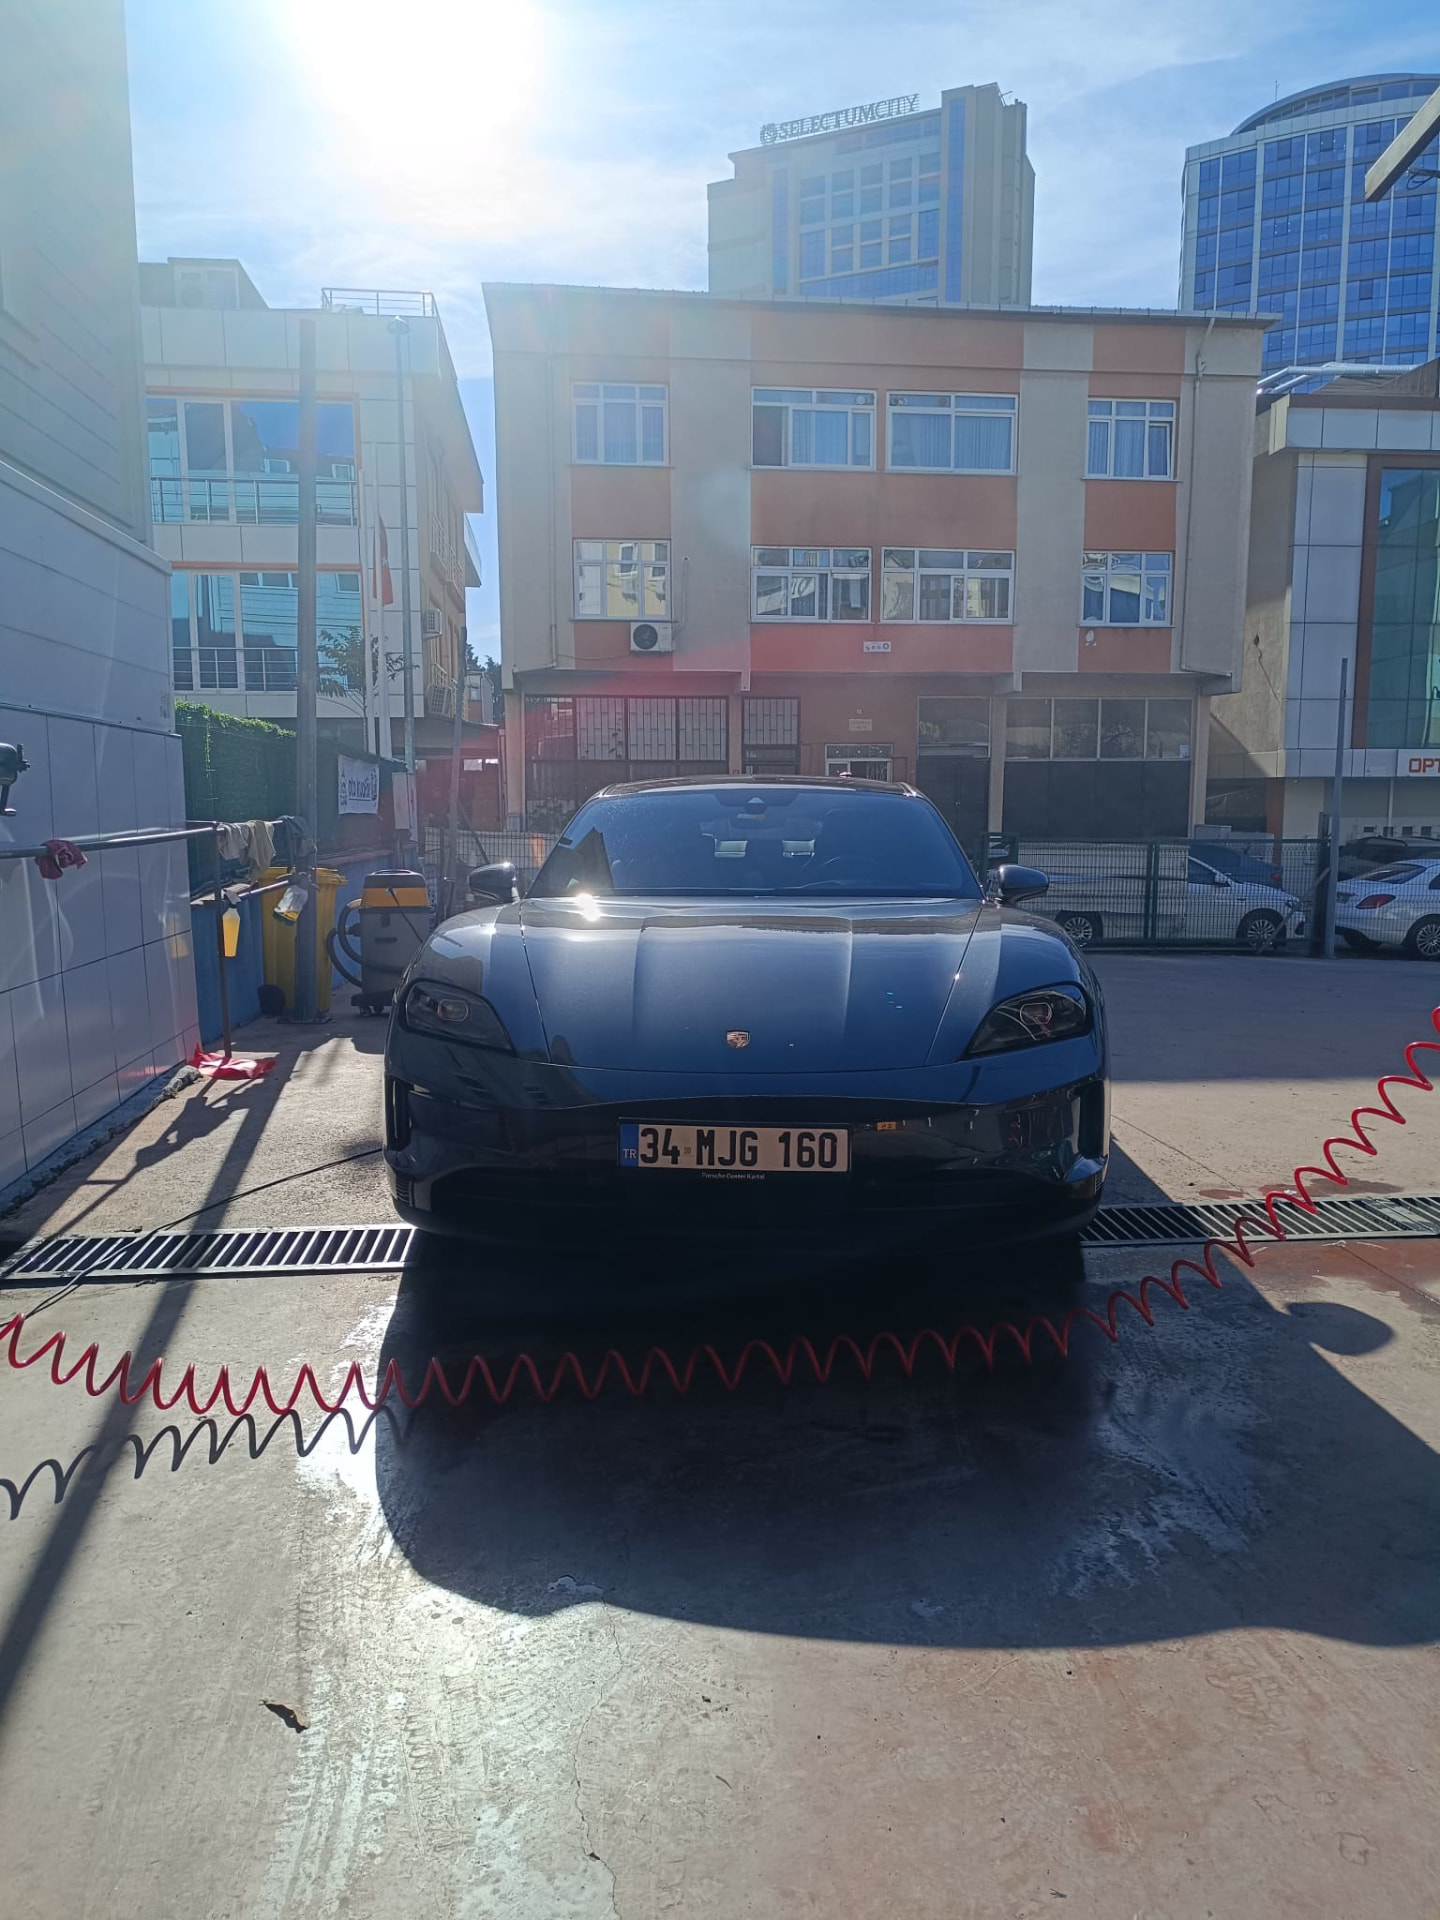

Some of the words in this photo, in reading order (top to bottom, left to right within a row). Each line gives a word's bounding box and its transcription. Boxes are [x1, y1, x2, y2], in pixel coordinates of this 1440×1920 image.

[623, 1149, 637, 1159] TR
[640, 1128, 681, 1165] 34
[697, 1129, 758, 1166] MJG
[778, 1131, 838, 1168] 160
